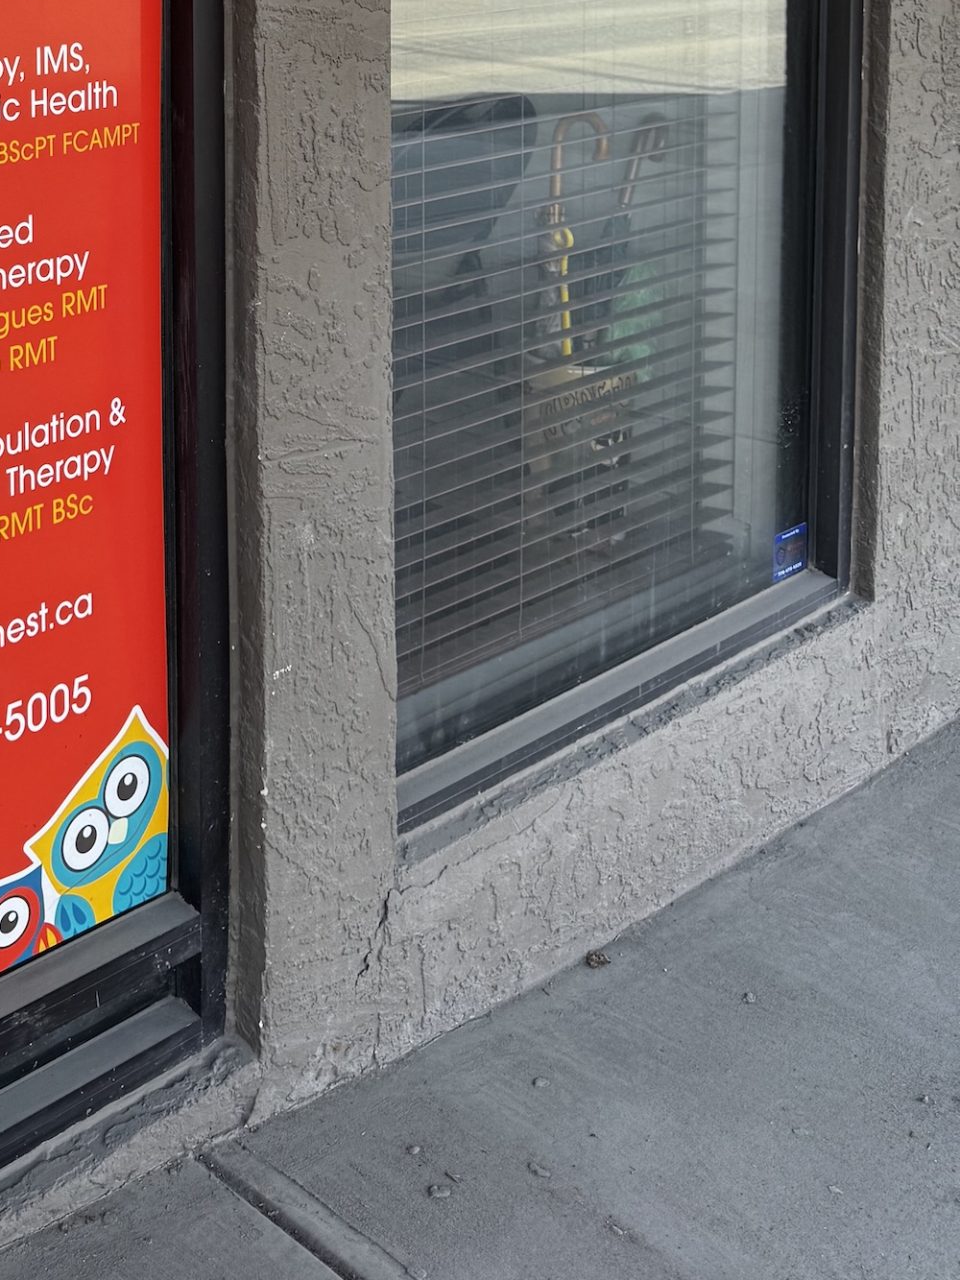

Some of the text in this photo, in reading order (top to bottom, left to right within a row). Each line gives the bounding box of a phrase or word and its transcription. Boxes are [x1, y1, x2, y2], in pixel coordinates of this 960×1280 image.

[35, 42, 90, 76] IMS,
[30, 80, 118, 118] Health
[63, 123, 140, 155] FCAMPT
[62, 284, 107, 318] RMT
[9, 336, 58, 371] RMT
[110, 397, 126, 425] &
[6, 444, 115, 495] Therapy
[52, 493, 94, 525] BSc
